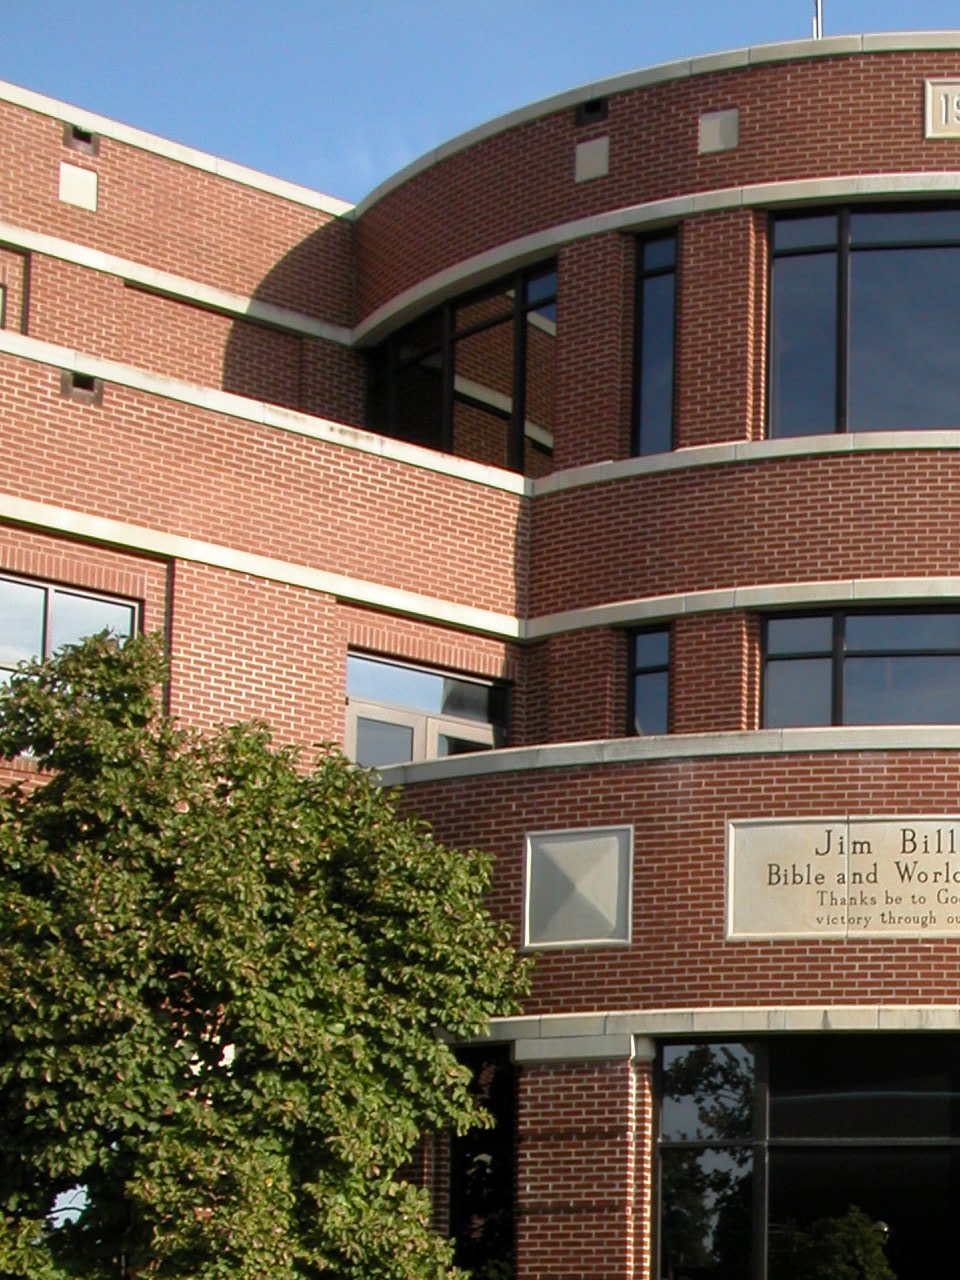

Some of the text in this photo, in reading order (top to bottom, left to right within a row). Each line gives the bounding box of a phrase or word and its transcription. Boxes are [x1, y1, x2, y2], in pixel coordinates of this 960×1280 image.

[815, 829, 873, 857] Jim
[900, 828, 957, 855] Bill
[767, 864, 825, 886] Bible
[837, 864, 878, 885] and
[816, 890, 877, 906] Thanks
[885, 890, 902, 906] be
[911, 892, 927, 906] to
[816, 912, 872, 928] victory
[881, 911, 936, 928] through
